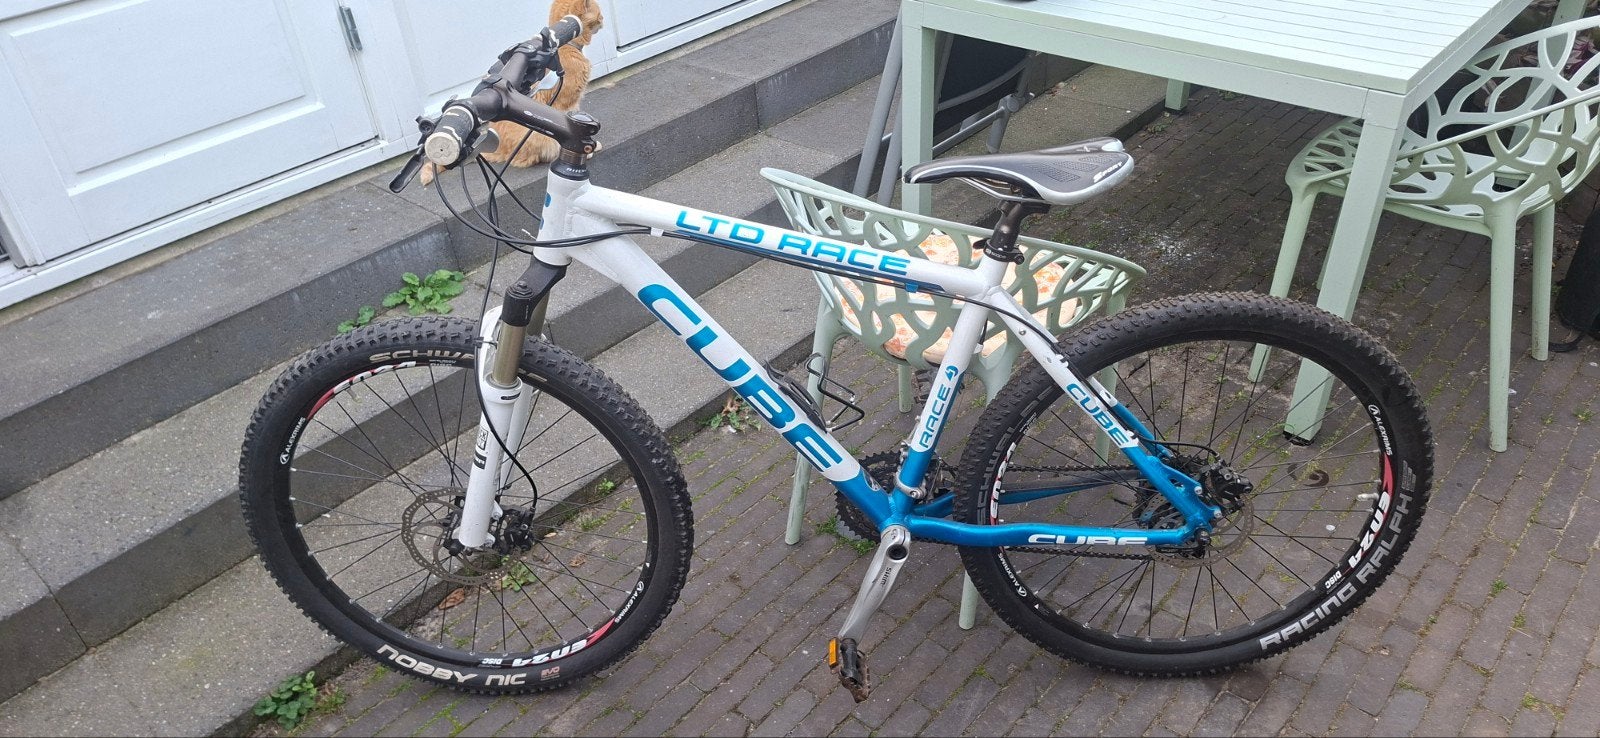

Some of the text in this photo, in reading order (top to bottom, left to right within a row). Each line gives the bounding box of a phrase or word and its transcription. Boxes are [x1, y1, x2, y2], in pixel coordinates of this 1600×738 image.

[676, 210, 911, 276] LTD RACE
[369, 349, 476, 363] SCHWA
[637, 284, 843, 473] CUBE
[919, 383, 951, 449] RACE
[1066, 383, 1130, 447] CUBE
[1258, 492, 1413, 651] RACING RALPH
[1324, 570, 1342, 589] DISC
[376, 643, 479, 684] NOBBY
[484, 672, 527, 687] NIC
[481, 657, 504, 666] DISC
